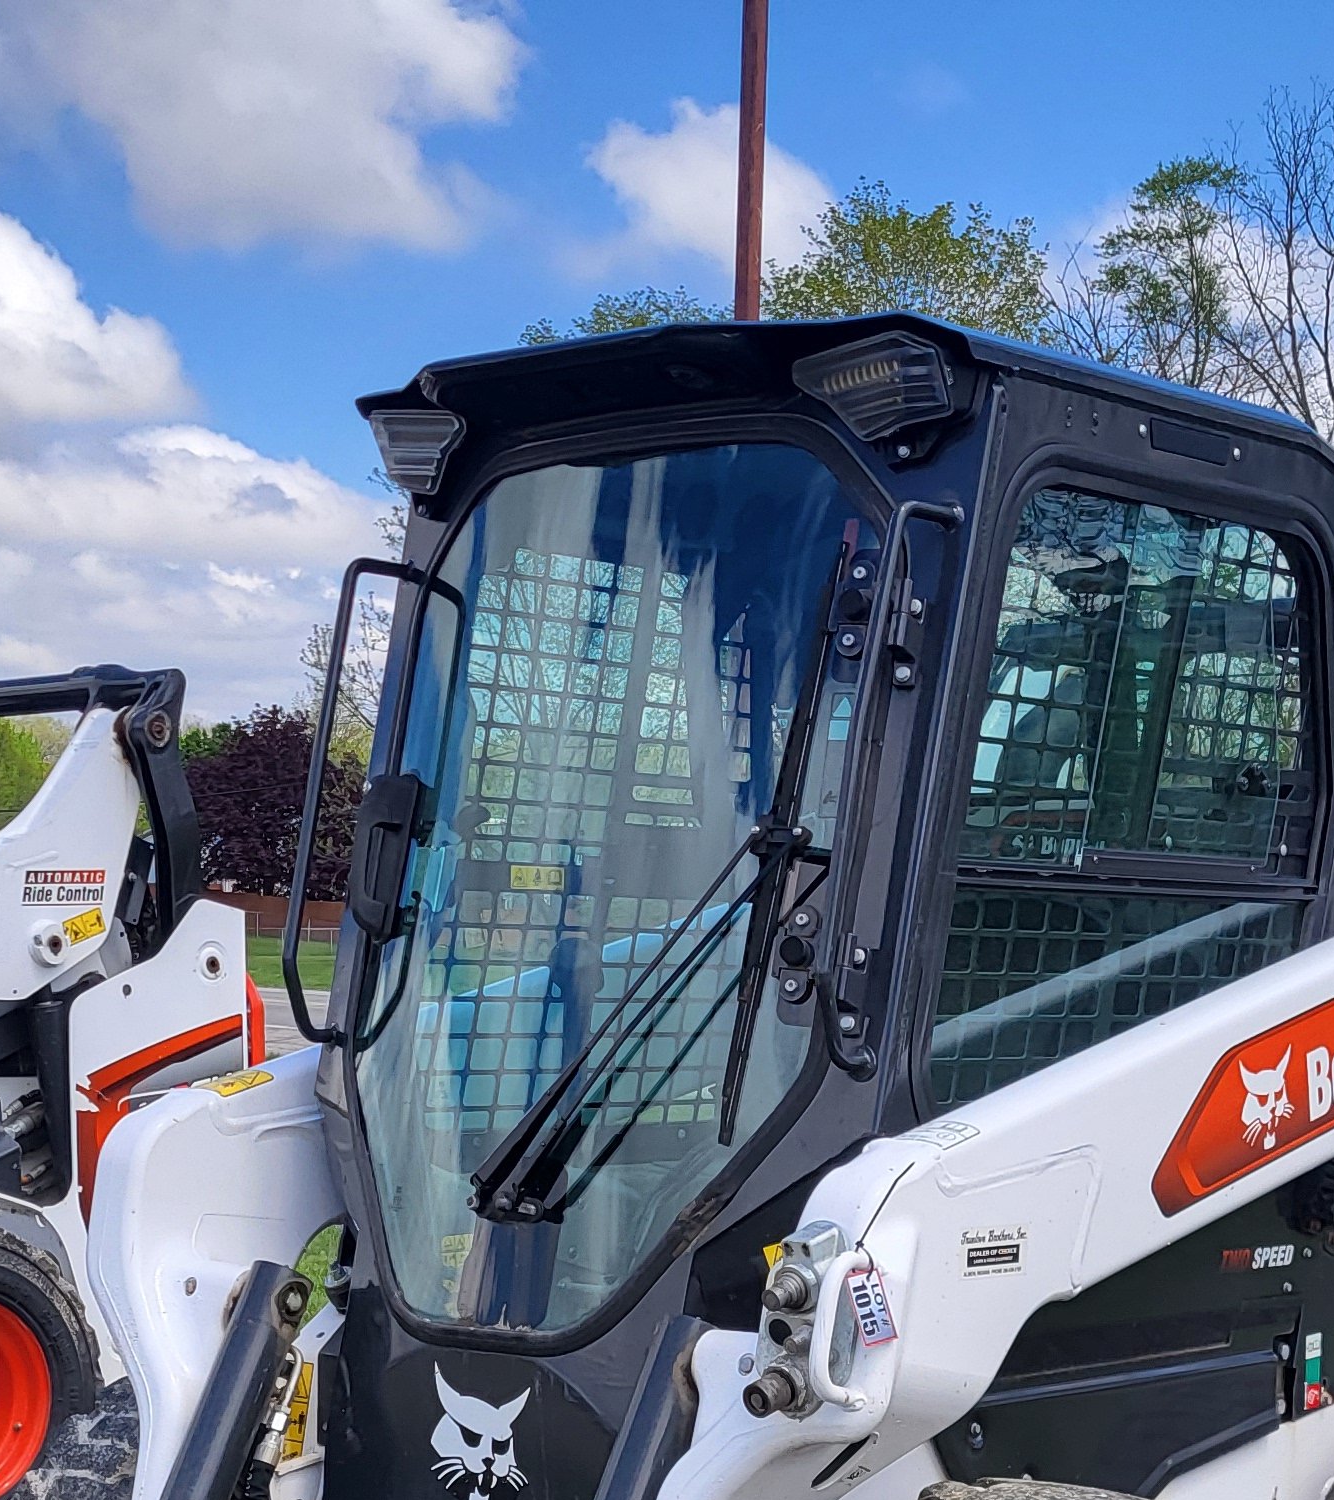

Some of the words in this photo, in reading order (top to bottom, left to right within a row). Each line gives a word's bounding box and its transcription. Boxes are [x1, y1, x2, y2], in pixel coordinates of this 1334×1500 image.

[27, 872, 104, 883] AUTOMATIC
[22, 886, 53, 902] Ride
[56, 886, 104, 902] Control
[1221, 1248, 1252, 1271] TWO
[1251, 1243, 1295, 1270] SPEED
[852, 1280, 880, 1337] 1015
[870, 1283, 887, 1314] LOT
